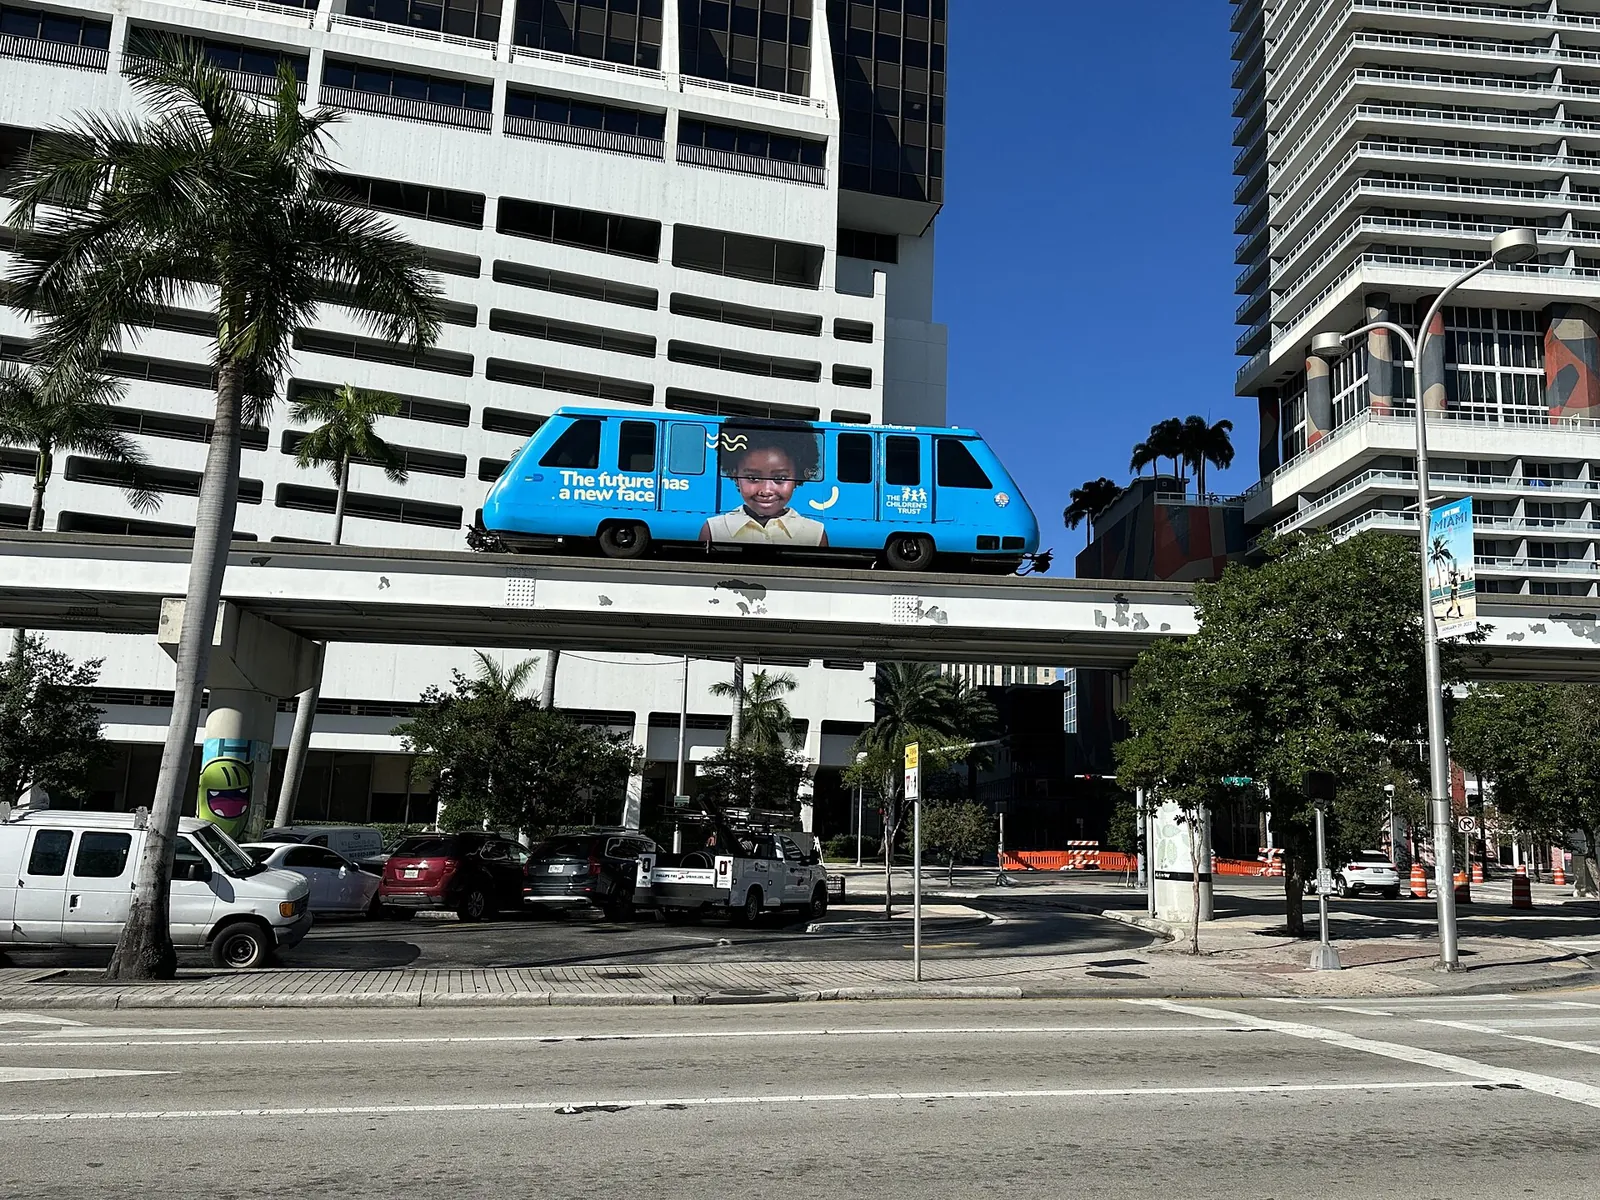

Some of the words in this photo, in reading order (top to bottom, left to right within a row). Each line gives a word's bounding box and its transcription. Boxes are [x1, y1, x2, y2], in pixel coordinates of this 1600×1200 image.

[560, 470, 594, 487] The
[598, 472, 654, 488] future
[658, 474, 689, 490] has
[559, 488, 570, 500] a
[574, 488, 613, 501] new
[616, 486, 655, 502] face
[1434, 511, 1468, 531] MIAMI
